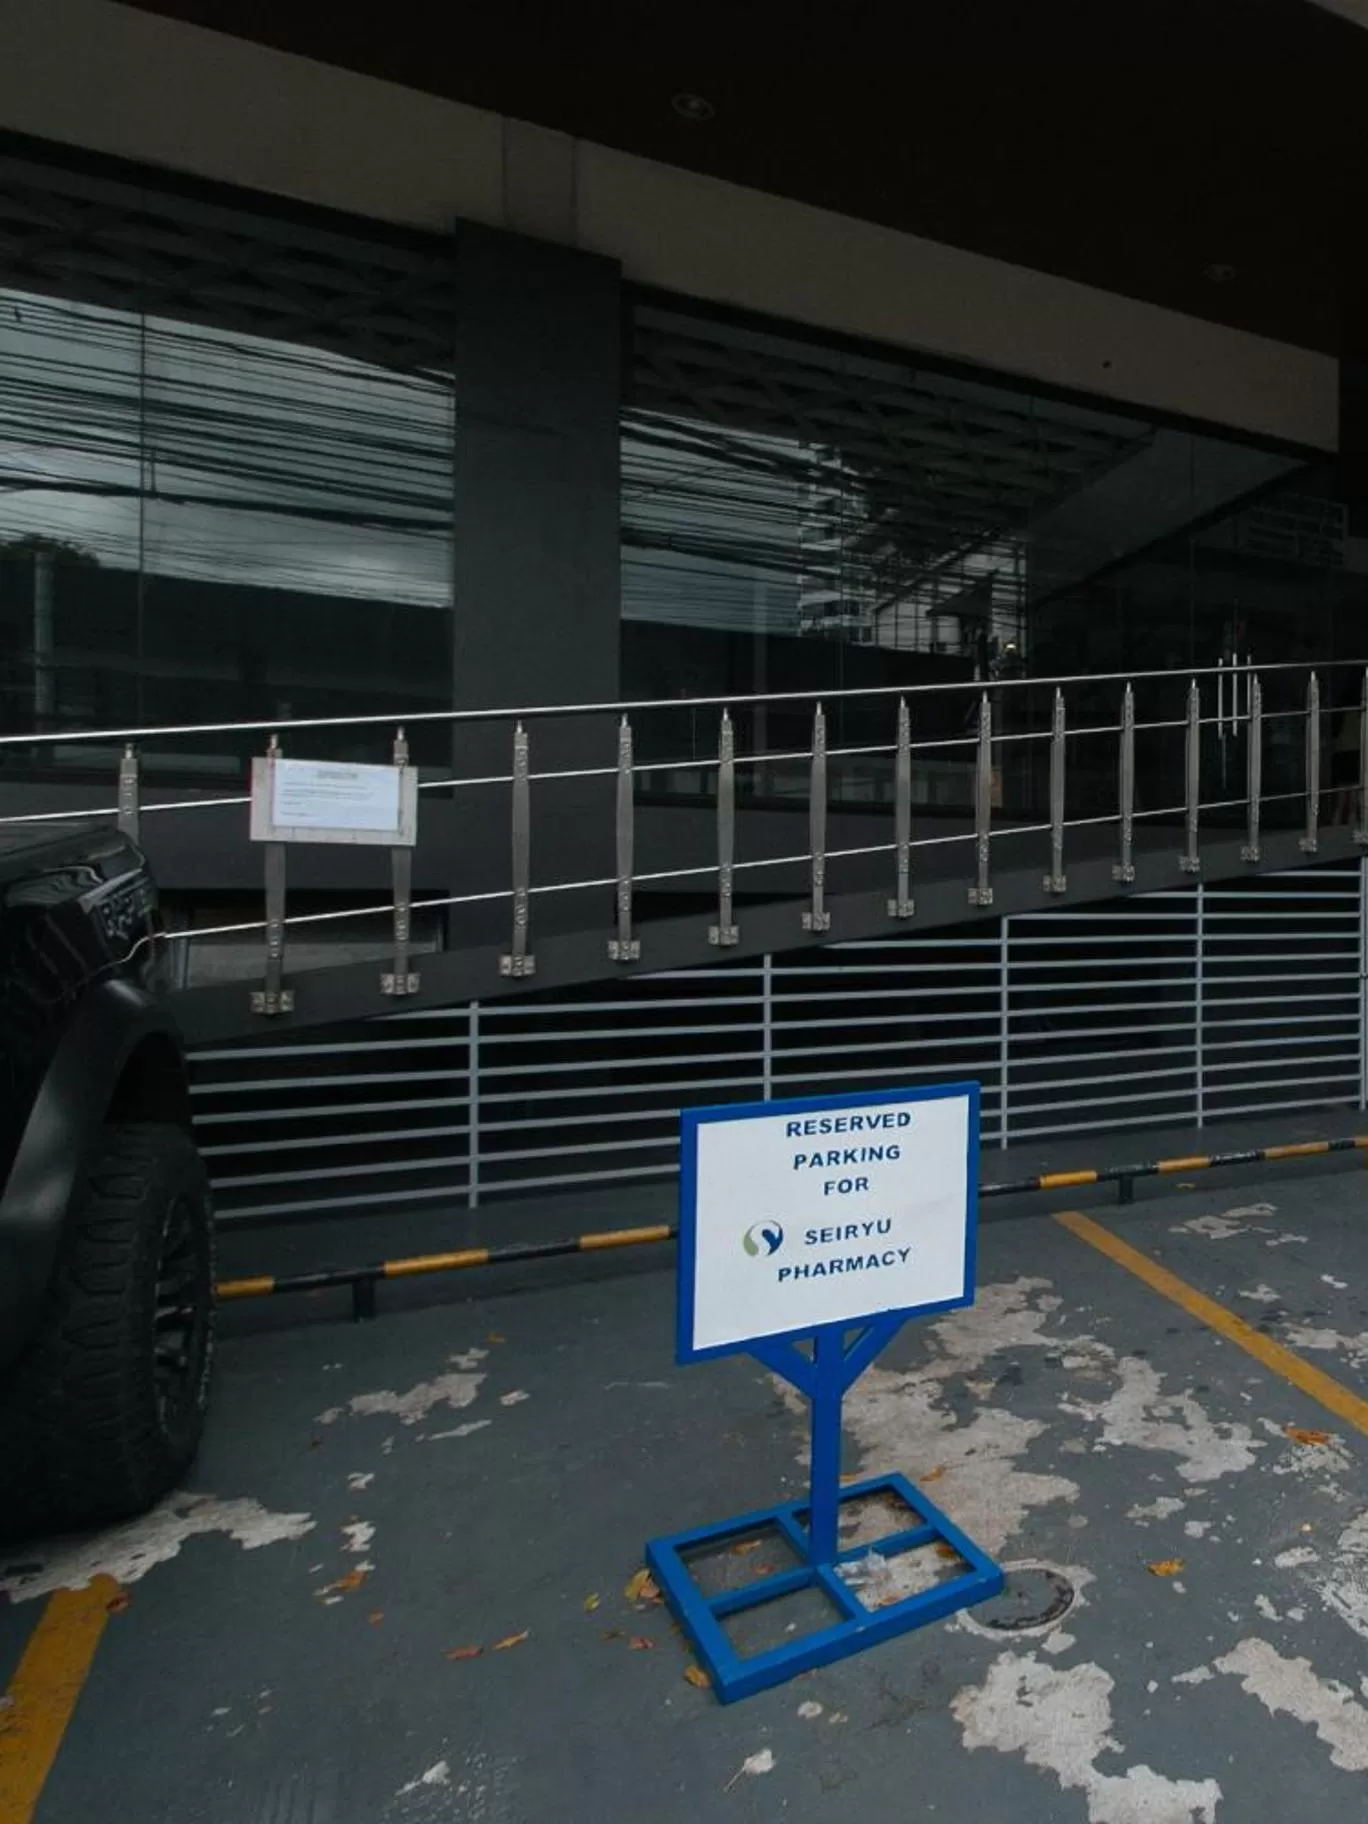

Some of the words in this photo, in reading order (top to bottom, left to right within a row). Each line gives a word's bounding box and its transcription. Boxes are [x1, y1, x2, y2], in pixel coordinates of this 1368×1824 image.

[785, 1111, 912, 1138] RESERVED
[792, 1144, 901, 1171] PARKING
[823, 1176, 870, 1197] FOR
[803, 1217, 892, 1246] SEIRYU
[777, 1247, 912, 1283] PHARMACY
